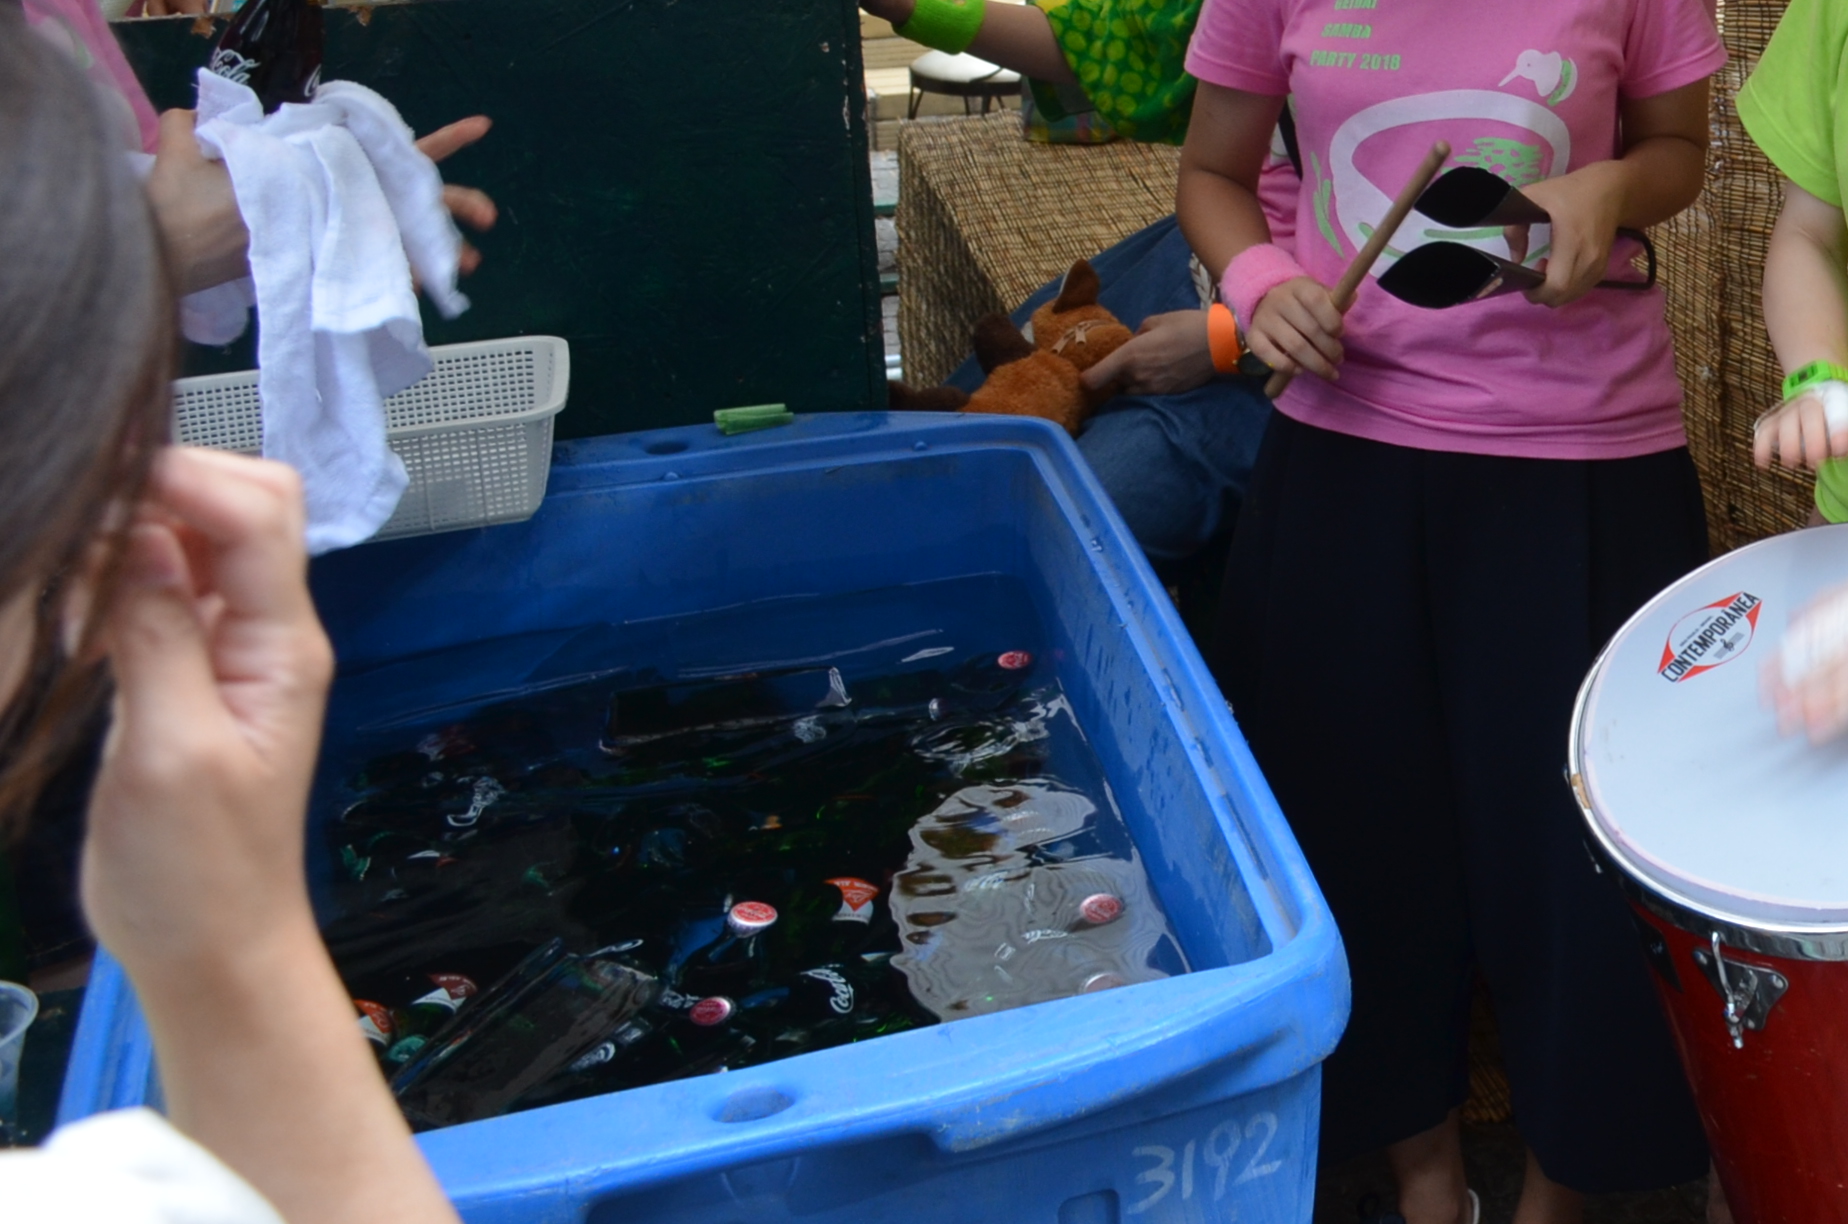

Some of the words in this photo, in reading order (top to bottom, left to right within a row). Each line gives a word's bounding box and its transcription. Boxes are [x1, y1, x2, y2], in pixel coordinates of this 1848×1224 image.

[1321, 22, 1372, 39] SAMBA
[1310, 49, 1357, 69] PARTY
[1359, 52, 1401, 71] 2018
[1660, 591, 1760, 683] CONTEMPORÂNEA
[1126, 1111, 1283, 1215] 3192
